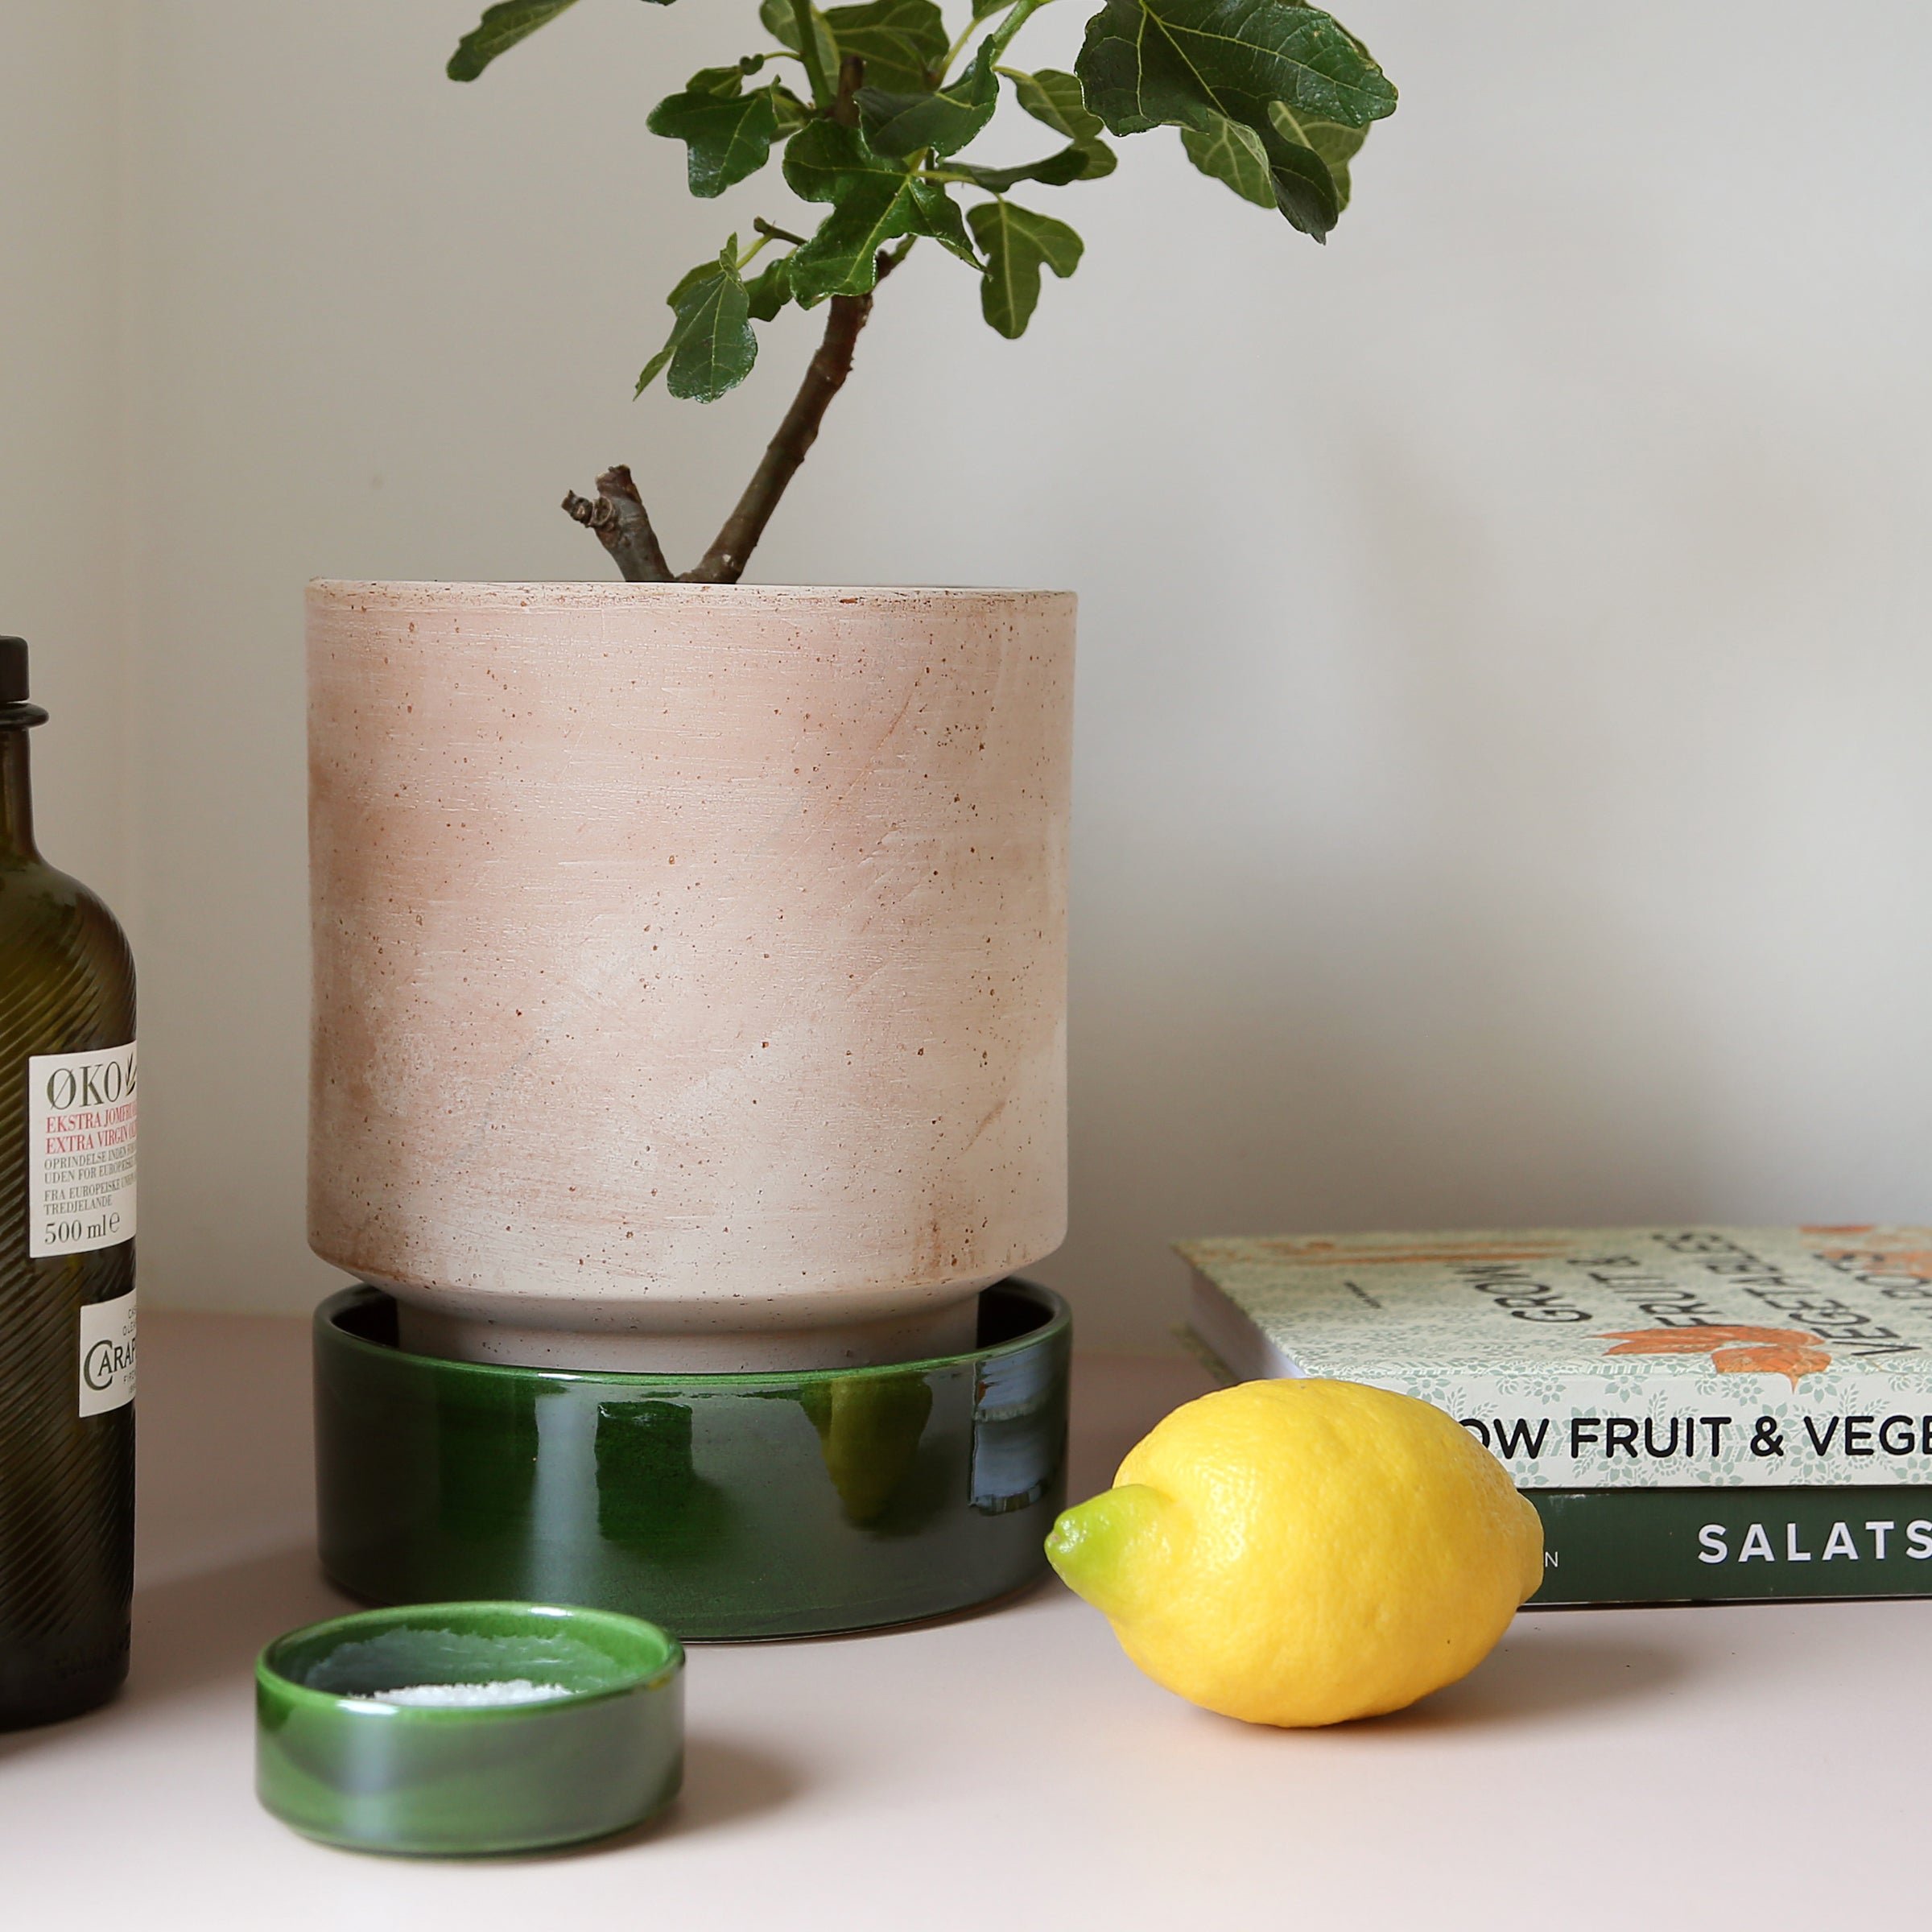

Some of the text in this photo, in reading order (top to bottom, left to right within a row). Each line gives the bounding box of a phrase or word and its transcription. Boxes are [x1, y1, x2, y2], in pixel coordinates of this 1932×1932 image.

[47, 1061, 121, 1110] ØKO
[46, 1112, 101, 1133] EKSTRA
[46, 1133, 94, 1154] EXTRA
[97, 1125, 128, 1147] VIRGIN
[44, 1150, 107, 1170] OPRINDELSE
[44, 1171, 75, 1184] UDEN
[78, 1166, 97, 1181] FOR
[43, 1195, 114, 1216] TREDJELANDE
[44, 1188, 66, 1202] FRA
[69, 1179, 120, 1199] EUROPEISKE
[44, 1220, 81, 1245] 500
[87, 1215, 106, 1240] ml
[1445, 1263, 1593, 1323] GROW
[1588, 1273, 1745, 1328] FRUIT
[1652, 1233, 1923, 1356] VEGETABLES
[1571, 1417, 1732, 1459] FRUIT
[1750, 1416, 1785, 1457] &
[1698, 1520, 1932, 1563] SALATS
